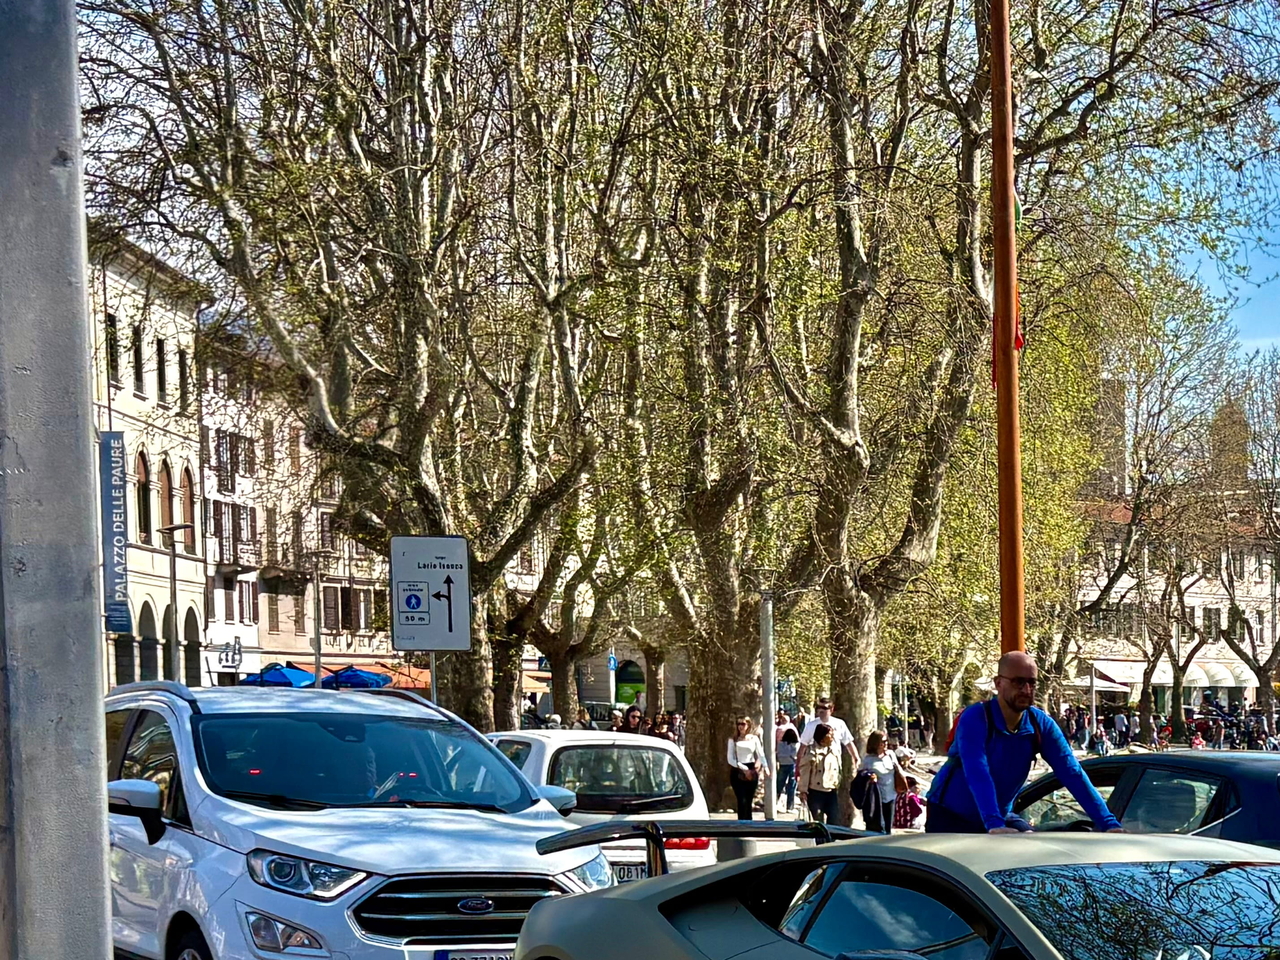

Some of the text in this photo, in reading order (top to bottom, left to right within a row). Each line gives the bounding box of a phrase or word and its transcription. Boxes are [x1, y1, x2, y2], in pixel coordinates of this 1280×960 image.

[110, 438, 124, 486] PAURE
[112, 488, 125, 532] DELLE
[113, 535, 127, 602] PALAZZO
